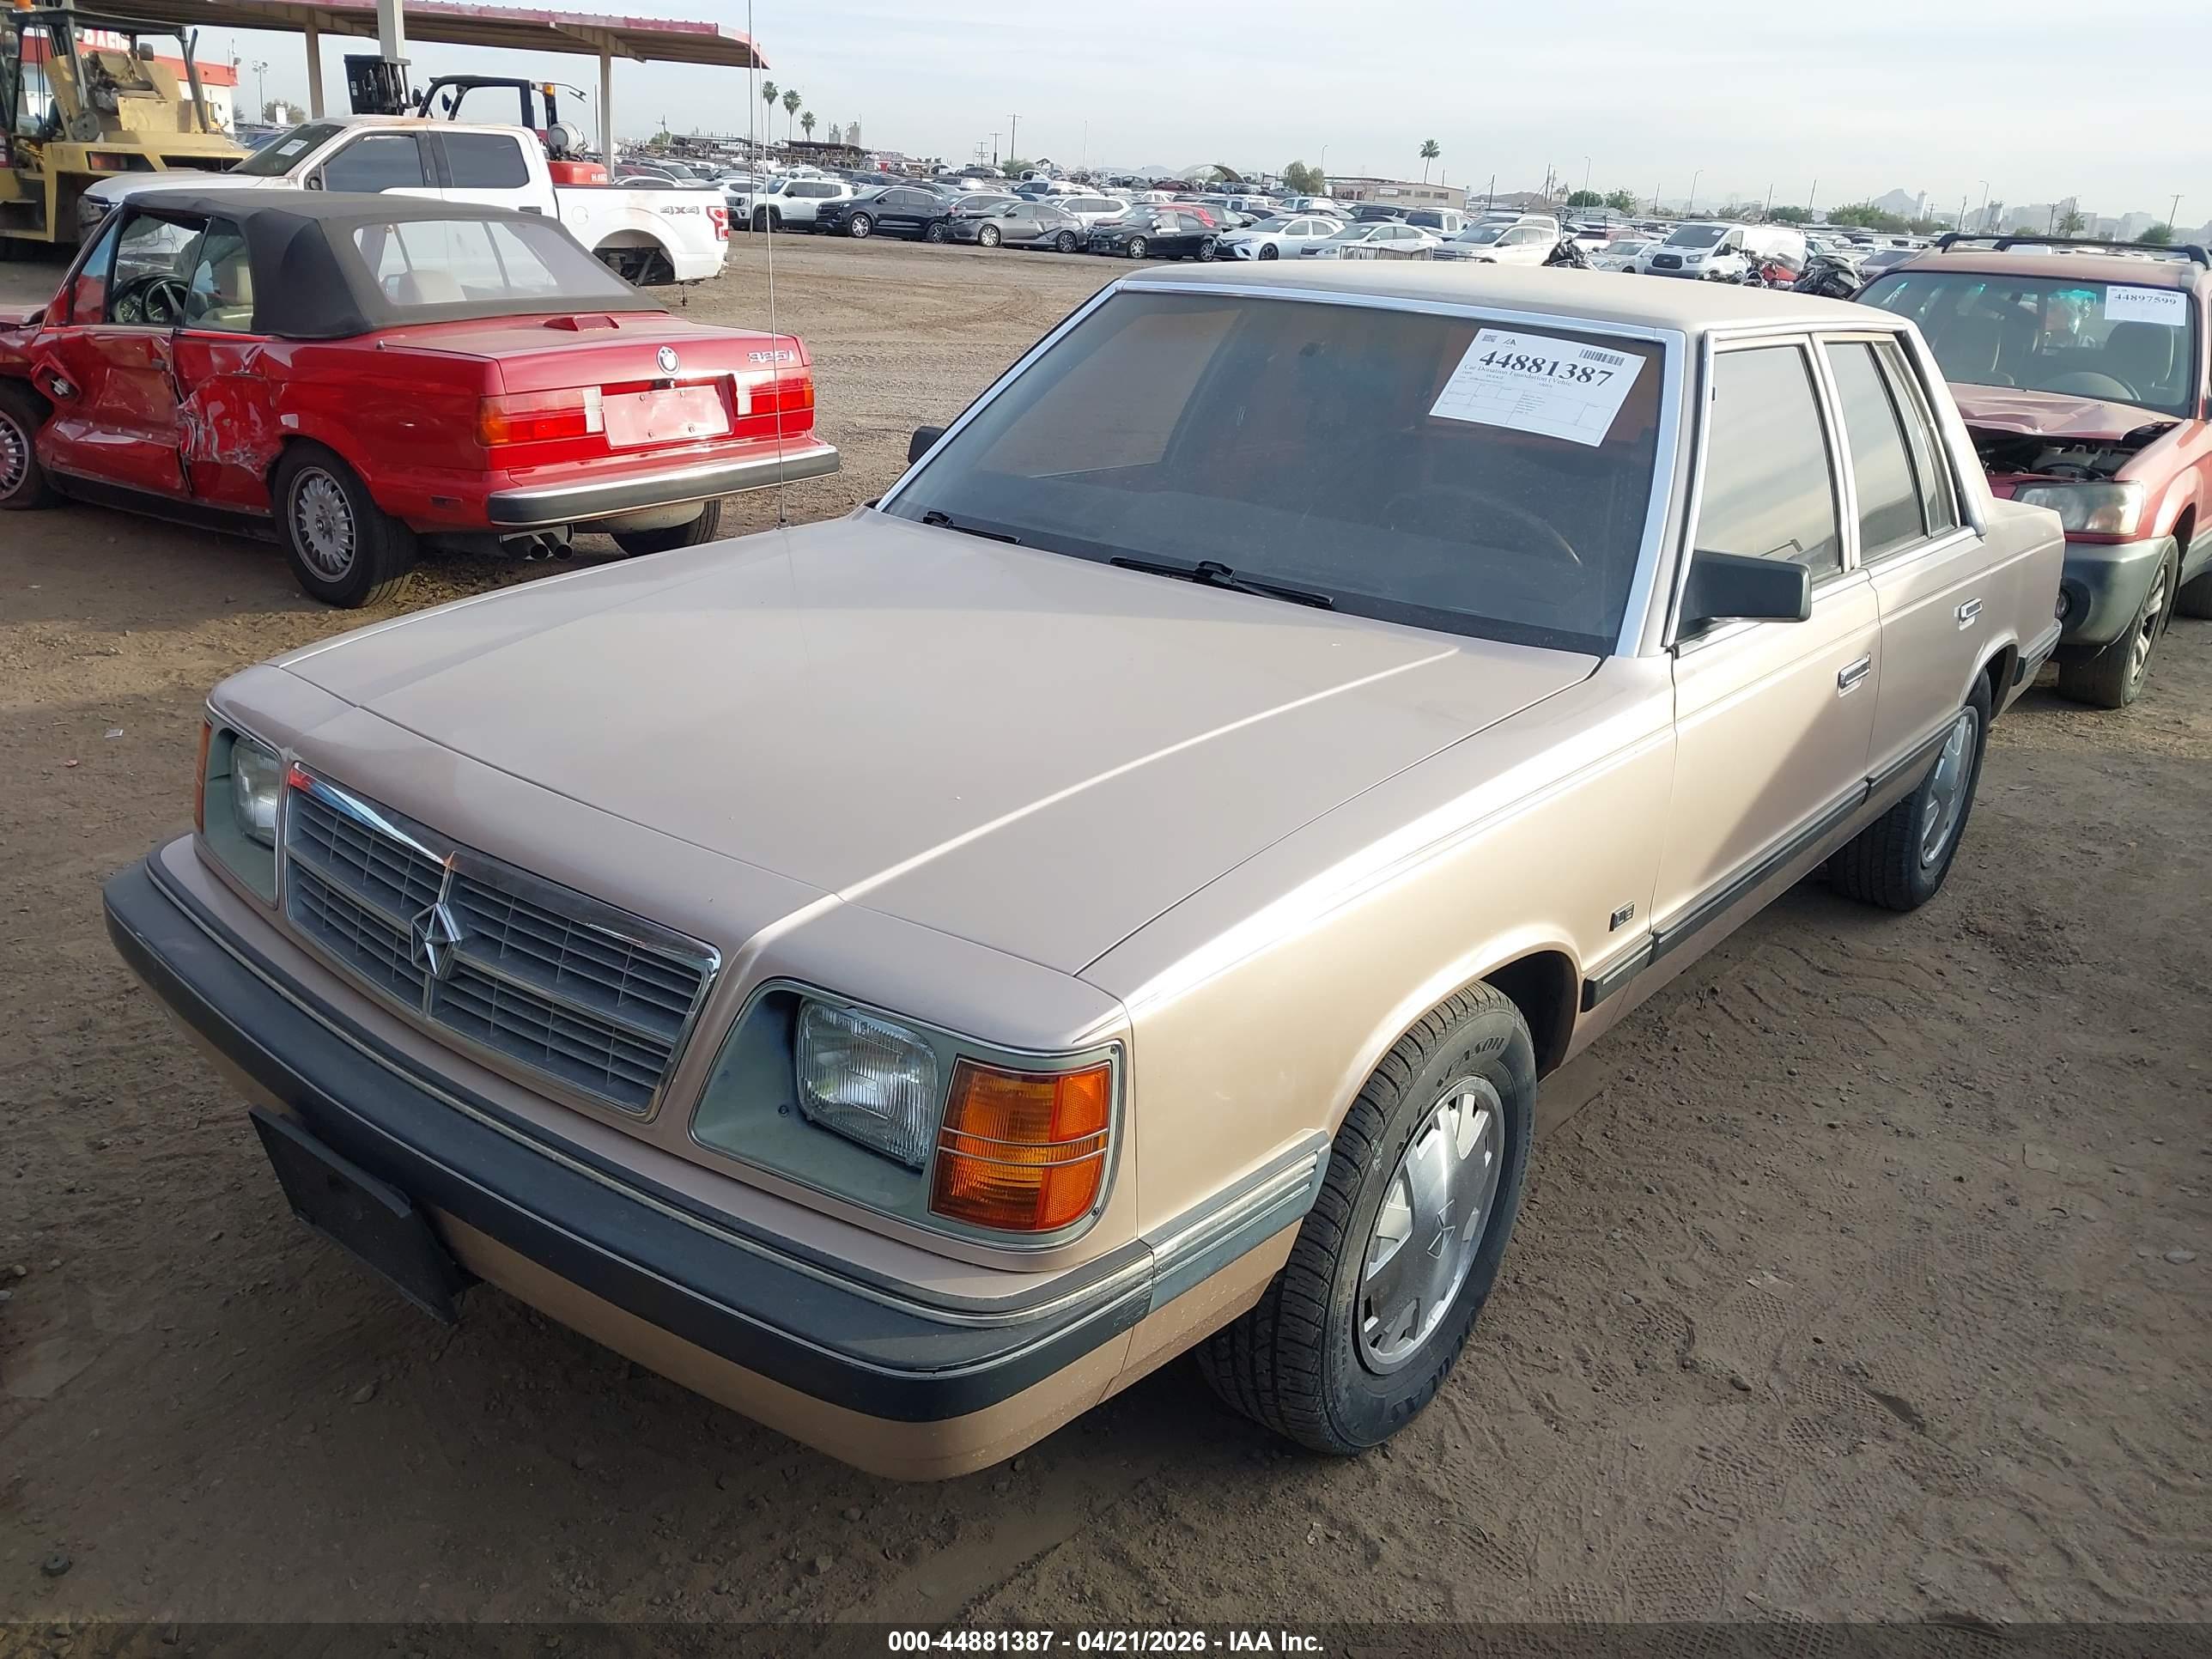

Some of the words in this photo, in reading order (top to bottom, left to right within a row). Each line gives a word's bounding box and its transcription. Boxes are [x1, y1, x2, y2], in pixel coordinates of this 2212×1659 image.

[2114, 294, 2177, 305] 44897599
[1477, 364, 1508, 375] Donation
[1510, 370, 1547, 382] Foundation
[1479, 350, 1614, 387] 44881387
